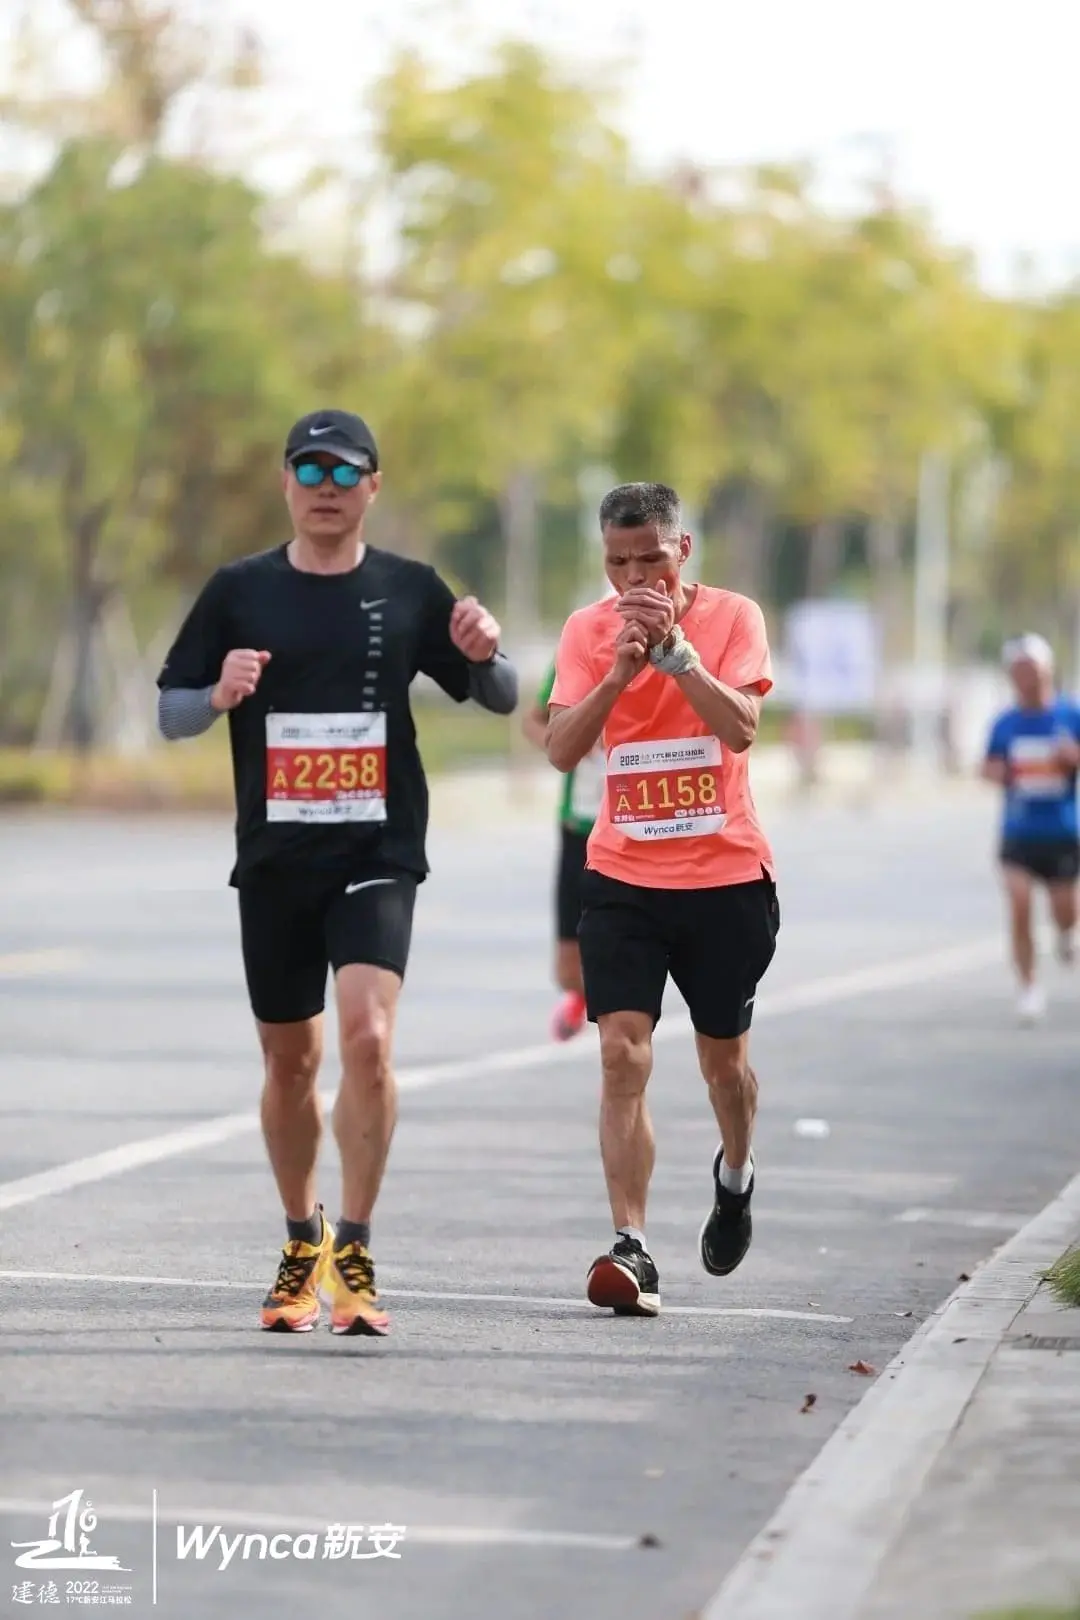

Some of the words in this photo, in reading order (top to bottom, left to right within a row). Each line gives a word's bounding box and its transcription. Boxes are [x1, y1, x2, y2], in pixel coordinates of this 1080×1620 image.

[368, 612, 383, 658] NIKE
[273, 768, 288, 788] A
[293, 752, 379, 789] 2258
[620, 754, 640, 767] 2022
[616, 794, 632, 812] A
[636, 773, 717, 810] 1158
[644, 824, 675, 836] Wynca
